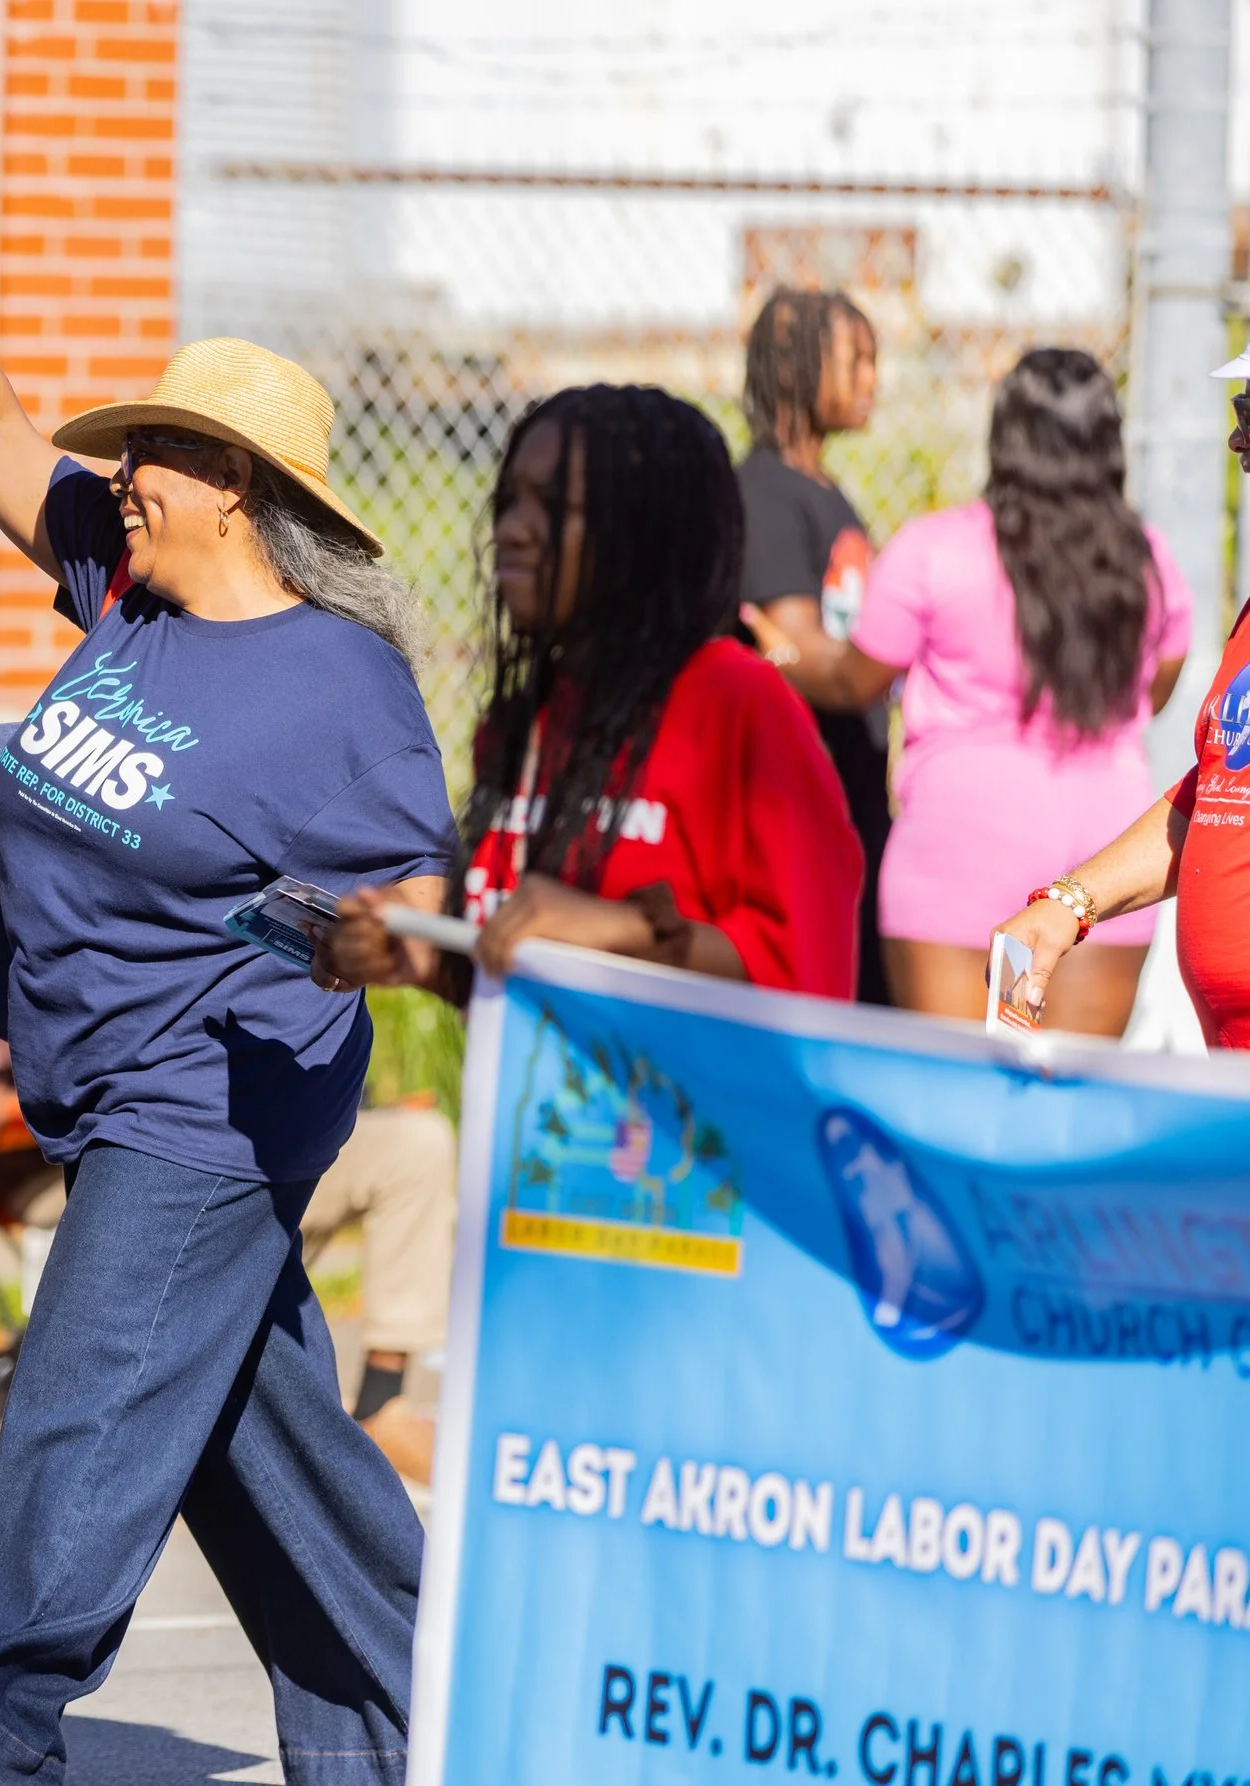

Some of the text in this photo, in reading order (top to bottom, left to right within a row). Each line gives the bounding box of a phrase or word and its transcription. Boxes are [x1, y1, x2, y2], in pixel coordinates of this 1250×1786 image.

[51, 652, 199, 751] Veronica
[20, 700, 165, 810] SIMS
[15, 764, 39, 791] REP.
[39, 781, 66, 807] FOR
[64, 797, 121, 838] DISTRICT
[121, 829, 142, 849] 33
[1221, 811, 1245, 827] Lives
[272, 939, 312, 962] SIMS
[1010, 1284, 1213, 1372] CHURCH
[493, 1431, 1250, 1632] EAST AKRON LABOR DAY PAR
[598, 1662, 724, 1758] REV.
[743, 1688, 838, 1780] DR.
